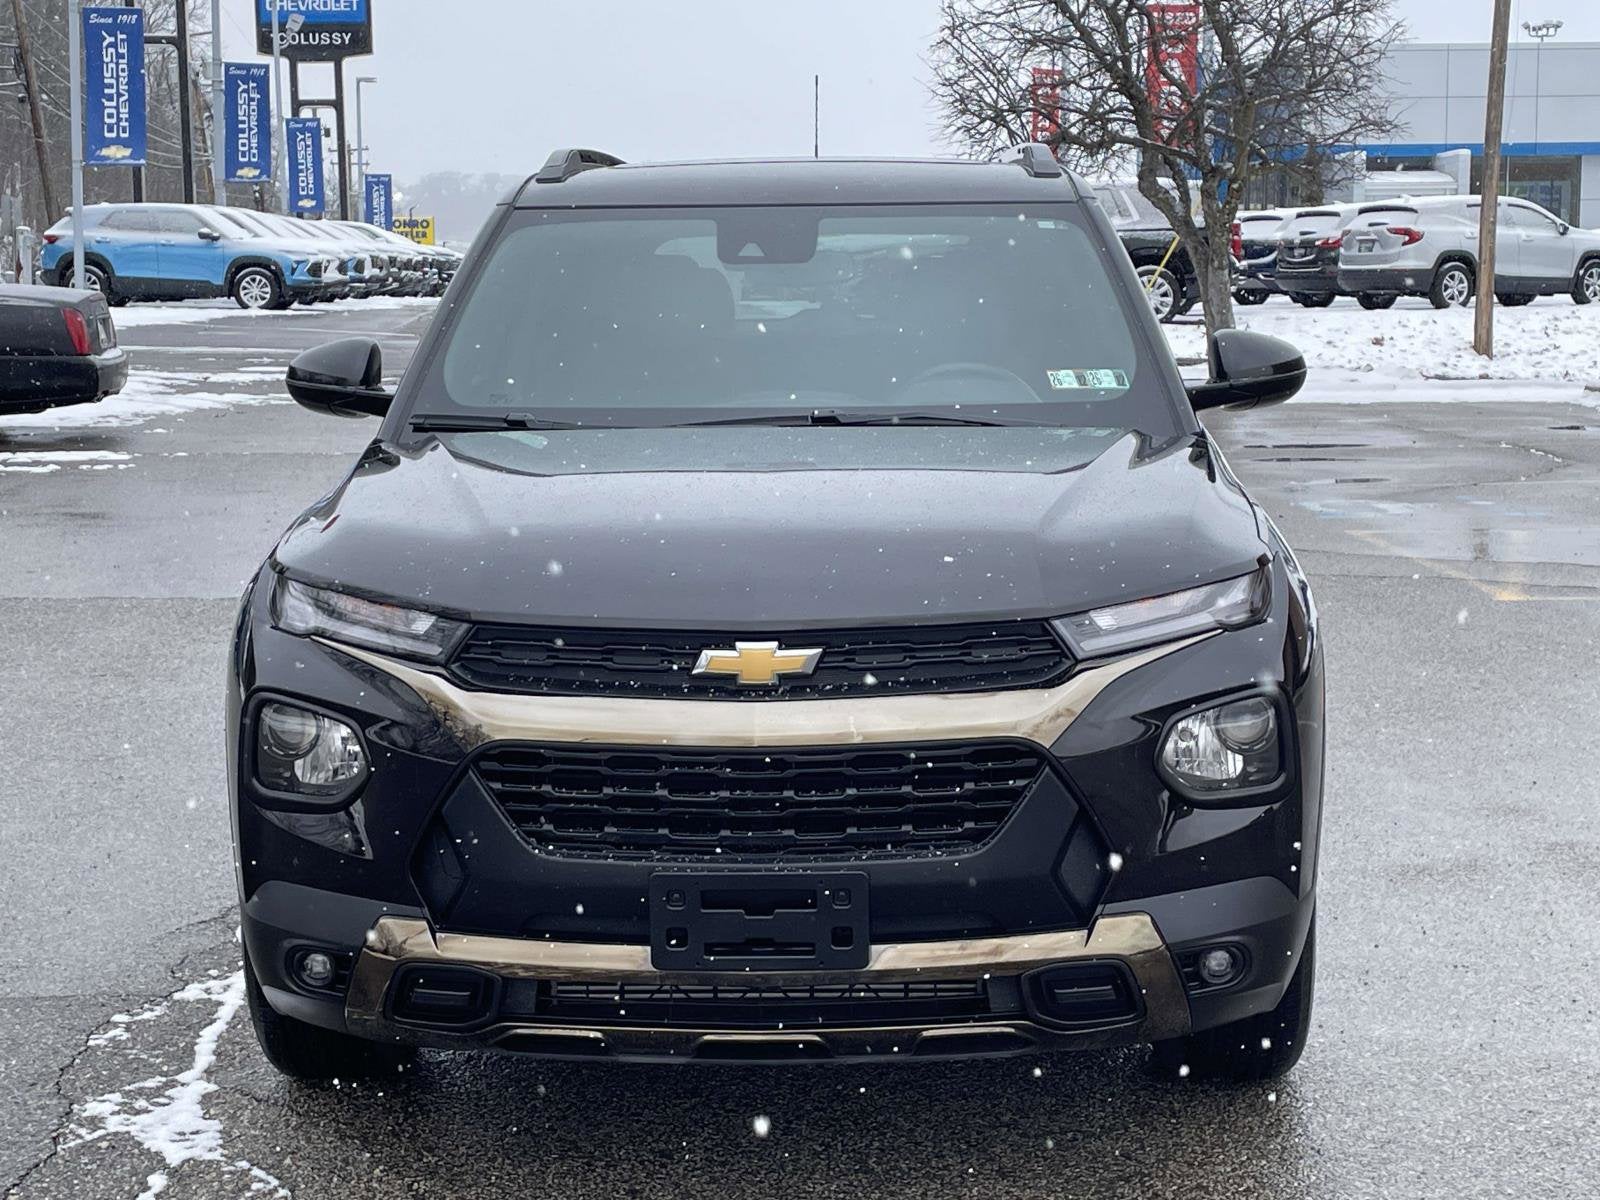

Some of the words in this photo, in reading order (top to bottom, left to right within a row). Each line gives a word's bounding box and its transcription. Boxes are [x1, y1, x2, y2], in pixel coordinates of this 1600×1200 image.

[89, 13, 113, 24] Since
[117, 14, 138, 24] 1918
[278, 32, 352, 45] COLUSSY
[101, 30, 117, 138] COLUSSY
[117, 30, 129, 138] CHEVROLET
[237, 80, 249, 162] COLUSSY
[249, 80, 259, 162] CHEVROLET
[296, 131, 307, 195] COLUSSY
[305, 131, 315, 195] CHEVROLET
[372, 183, 380, 226] OLUSSY
